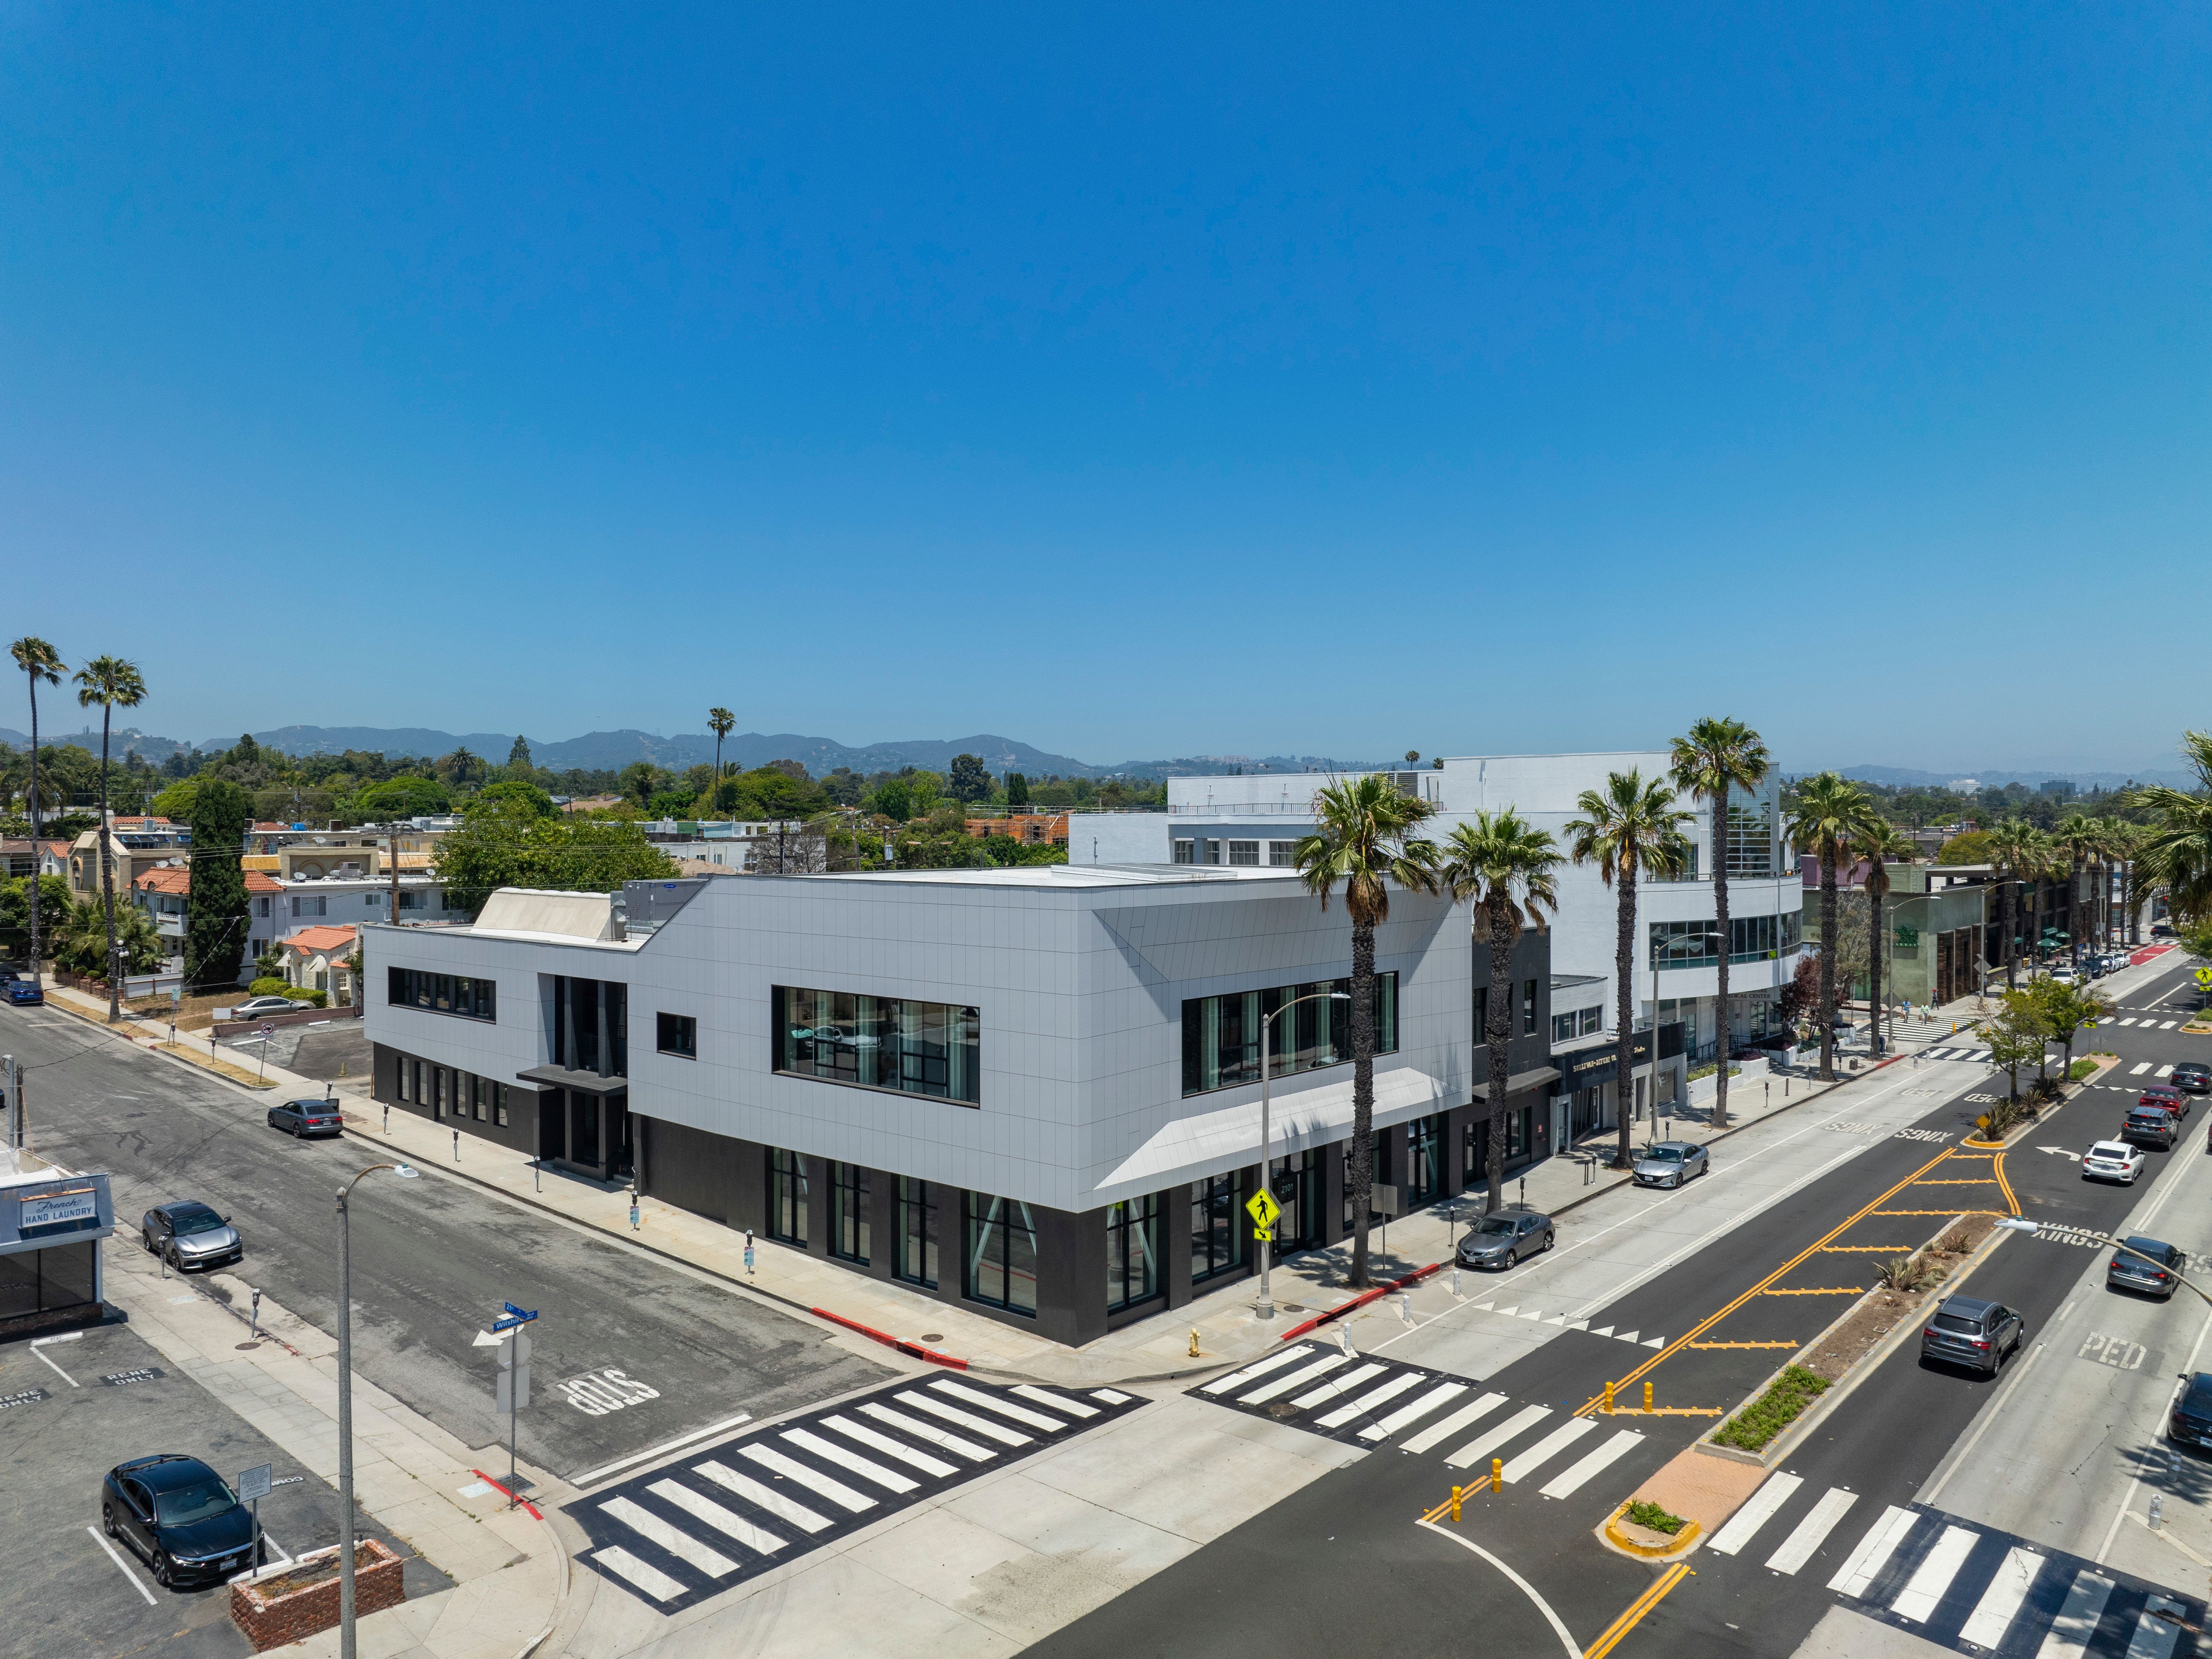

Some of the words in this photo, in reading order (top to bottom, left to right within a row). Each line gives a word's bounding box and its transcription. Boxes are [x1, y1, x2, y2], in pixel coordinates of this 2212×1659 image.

[1901, 1088, 1939, 1098] PED
[1825, 1121, 1884, 1135] XINGS
[1894, 1128, 1954, 1143] XINGS
[1281, 1183, 1293, 1193] 2101
[36, 1198, 82, 1213] French
[26, 1213, 48, 1224] HAND
[53, 1206, 92, 1219] LAUNDRY
[2031, 1222, 2109, 1248] XINGS
[2078, 1332, 2147, 1369] PED
[107, 1369, 151, 1380] RENE
[114, 1374, 154, 1385] ONLY
[557, 1369, 660, 1415] STOP
